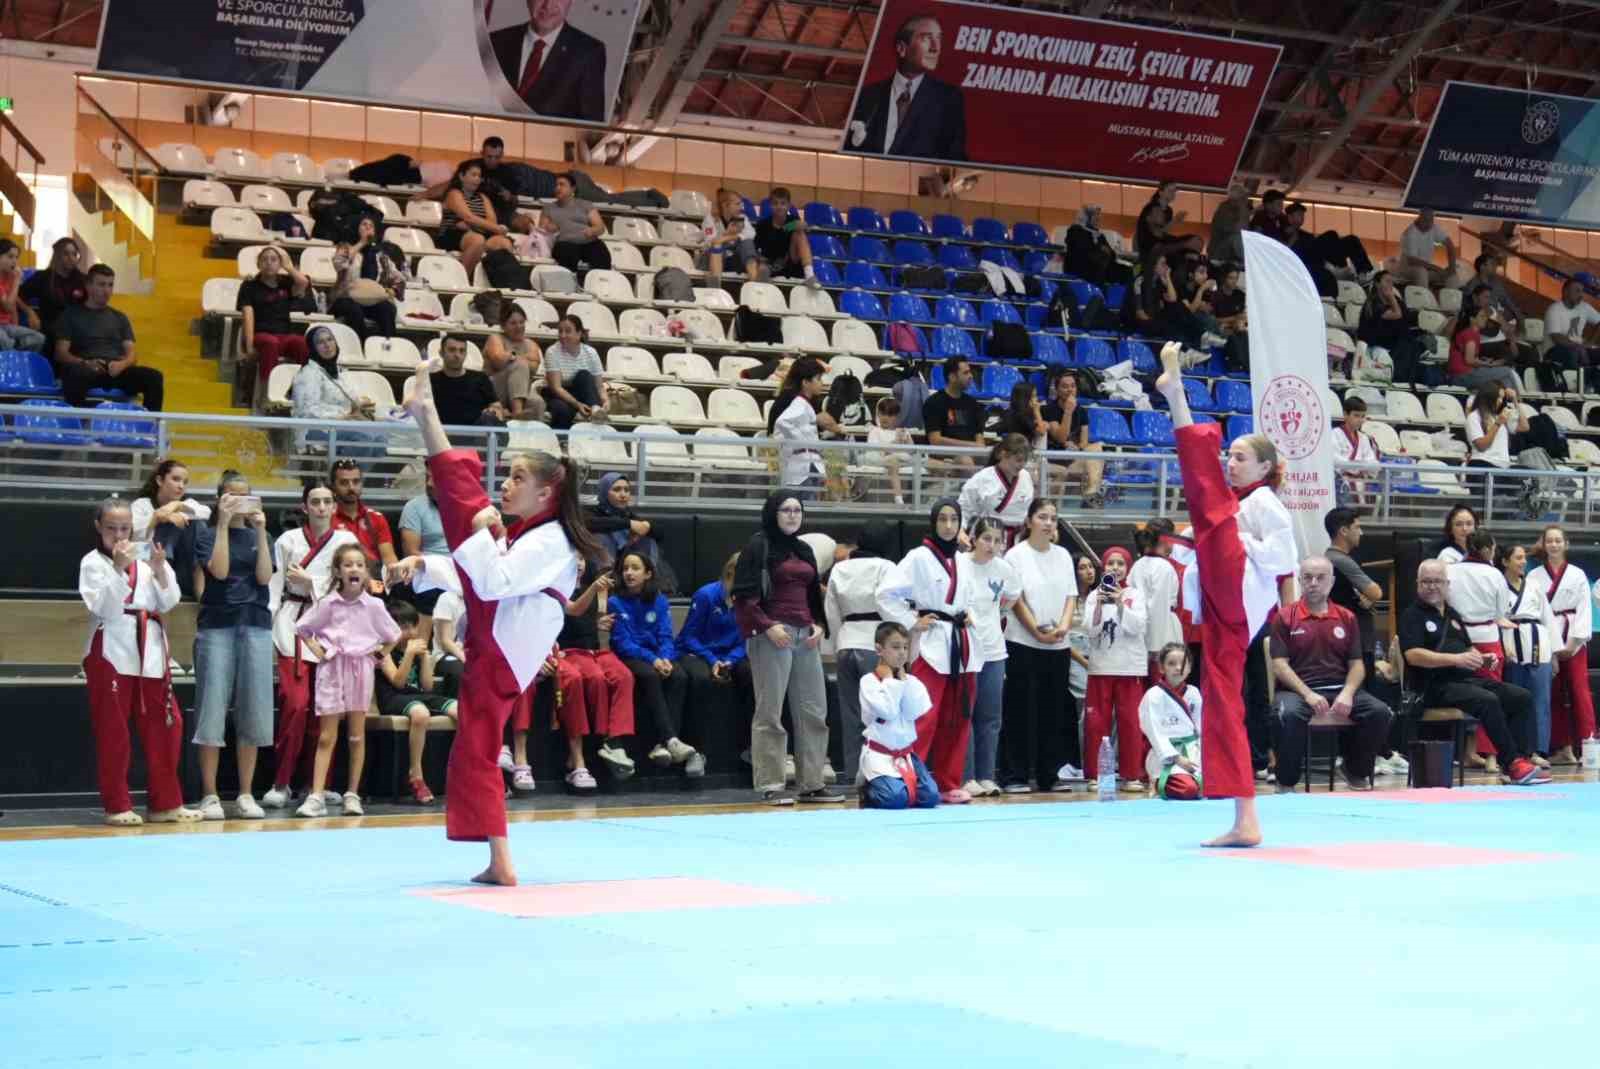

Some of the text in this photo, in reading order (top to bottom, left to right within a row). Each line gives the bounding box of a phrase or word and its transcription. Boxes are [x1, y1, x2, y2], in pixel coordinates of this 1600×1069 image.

[216, 12, 283, 28] BAŞARILAR
[954, 25, 1254, 88] BEN SPORCUNUN ZEKİ, ÇEVİK VE AYNI
[962, 63, 1221, 118] ZAMANDA AHLAKLISINI SEVERİM.
[1107, 123, 1151, 137] MUSTAFA
[1152, 129, 1183, 141] KEMAL
